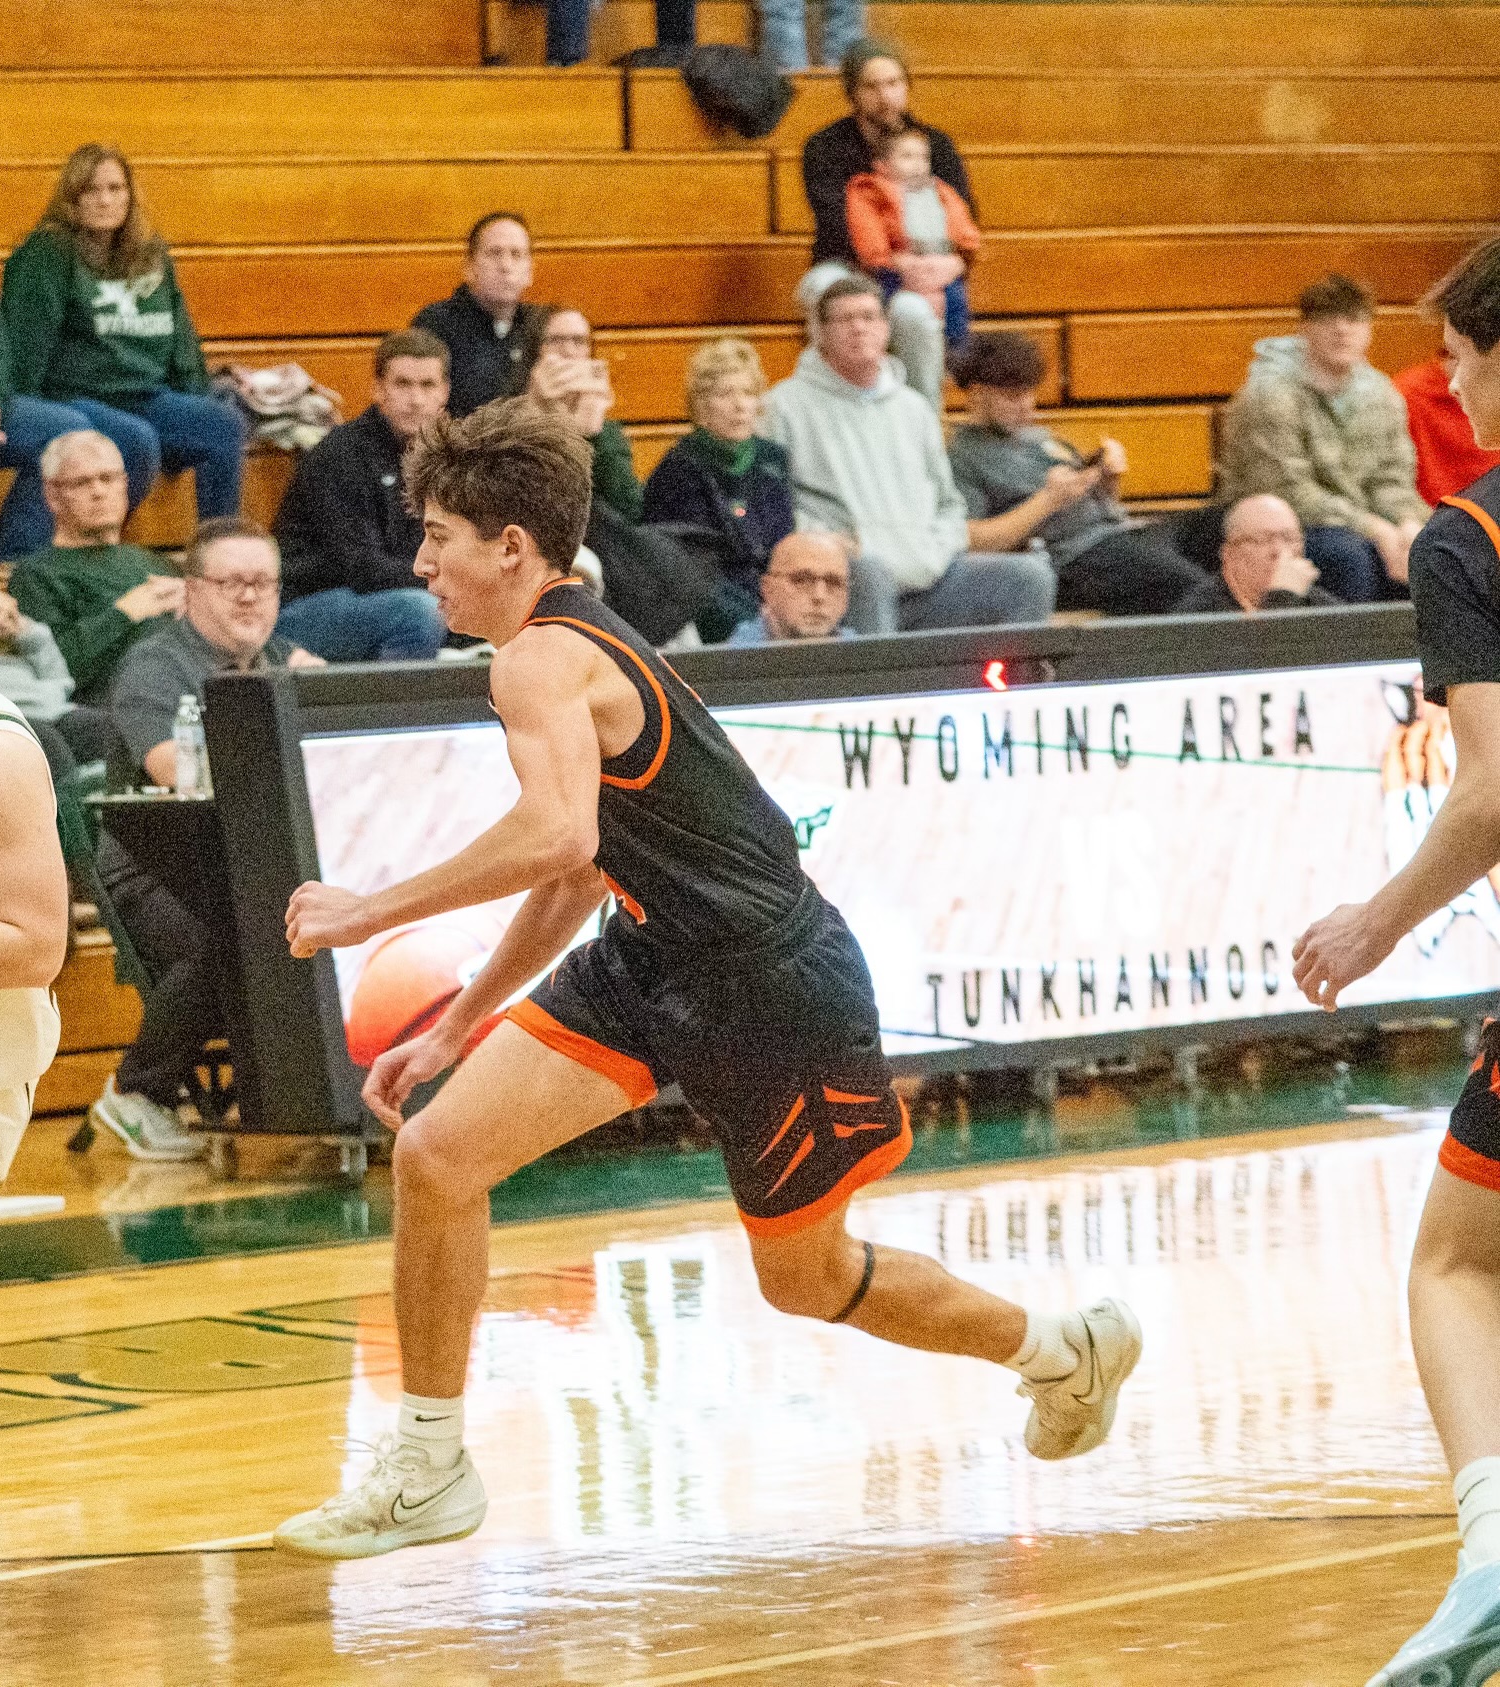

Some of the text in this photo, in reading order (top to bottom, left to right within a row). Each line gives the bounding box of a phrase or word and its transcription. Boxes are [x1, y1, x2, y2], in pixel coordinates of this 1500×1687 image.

[837, 688, 1318, 790] WYOMING AREA
[925, 938, 1300, 1038] TUNKHANNOC
